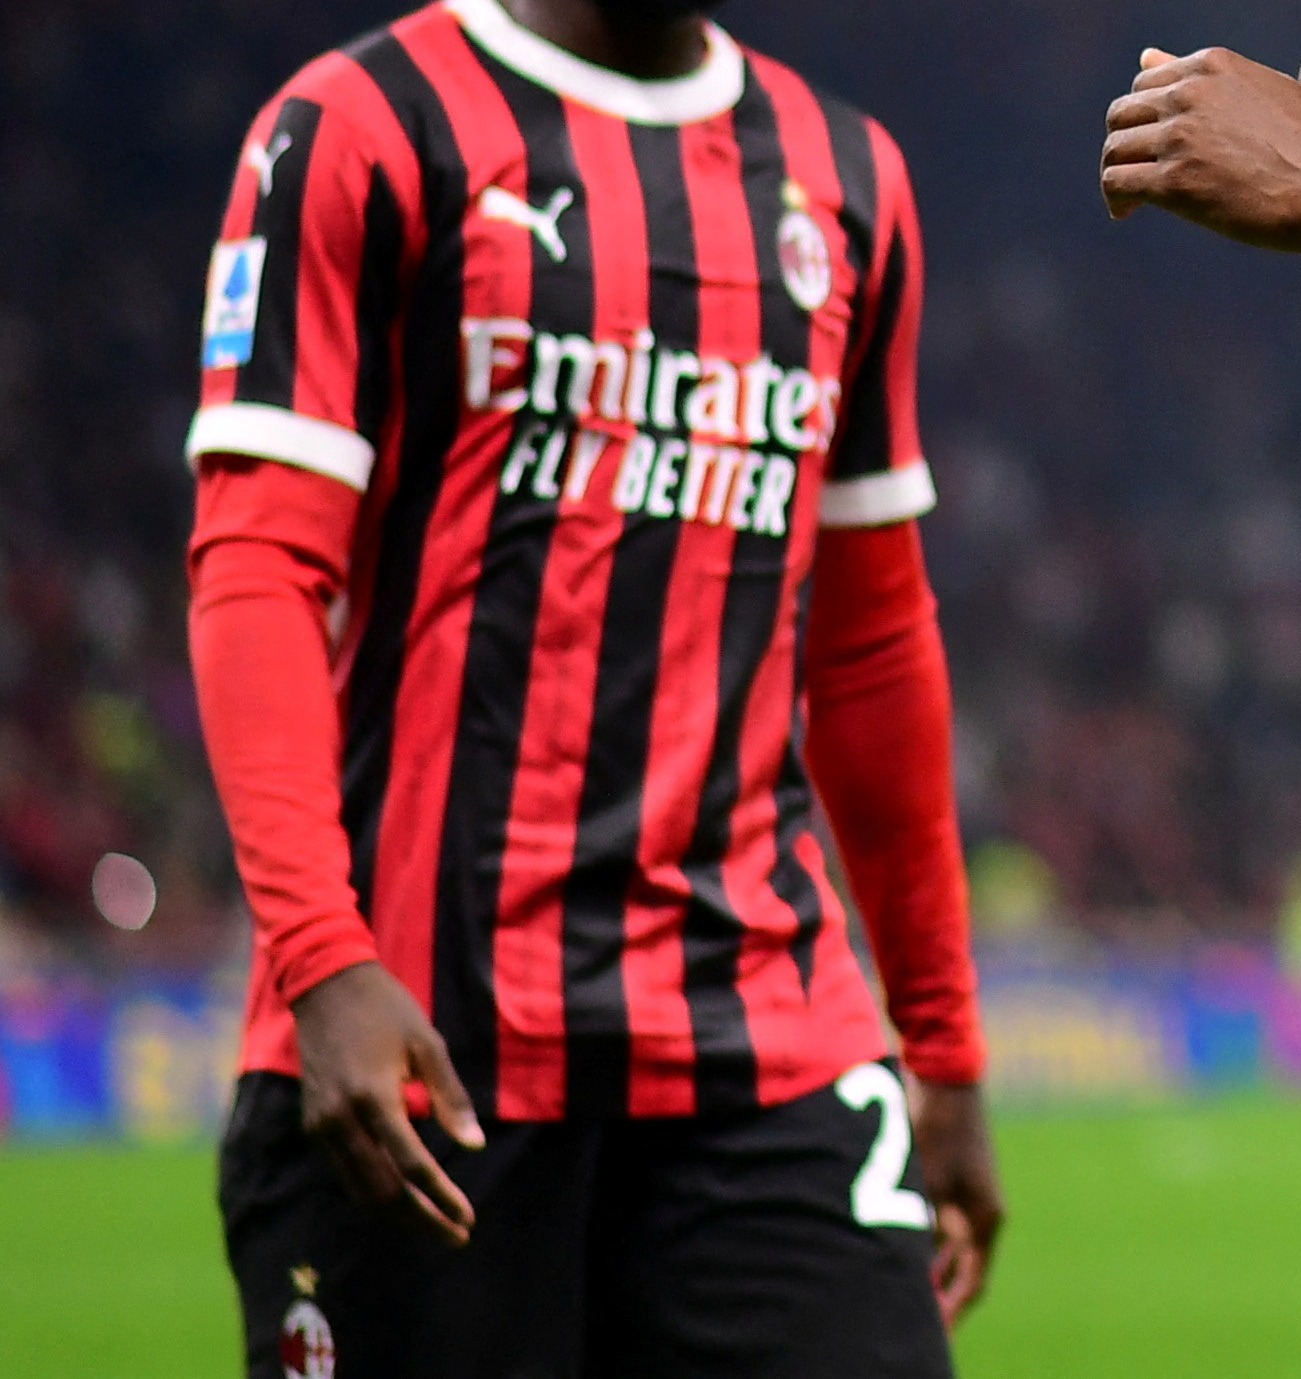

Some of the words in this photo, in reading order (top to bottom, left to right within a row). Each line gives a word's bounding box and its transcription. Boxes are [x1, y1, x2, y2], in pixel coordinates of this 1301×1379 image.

[460, 317, 842, 454] Emirates
[501, 422, 610, 501] FLY
[610, 431, 797, 537] BETTER
[835, 1061, 937, 1232] 2
